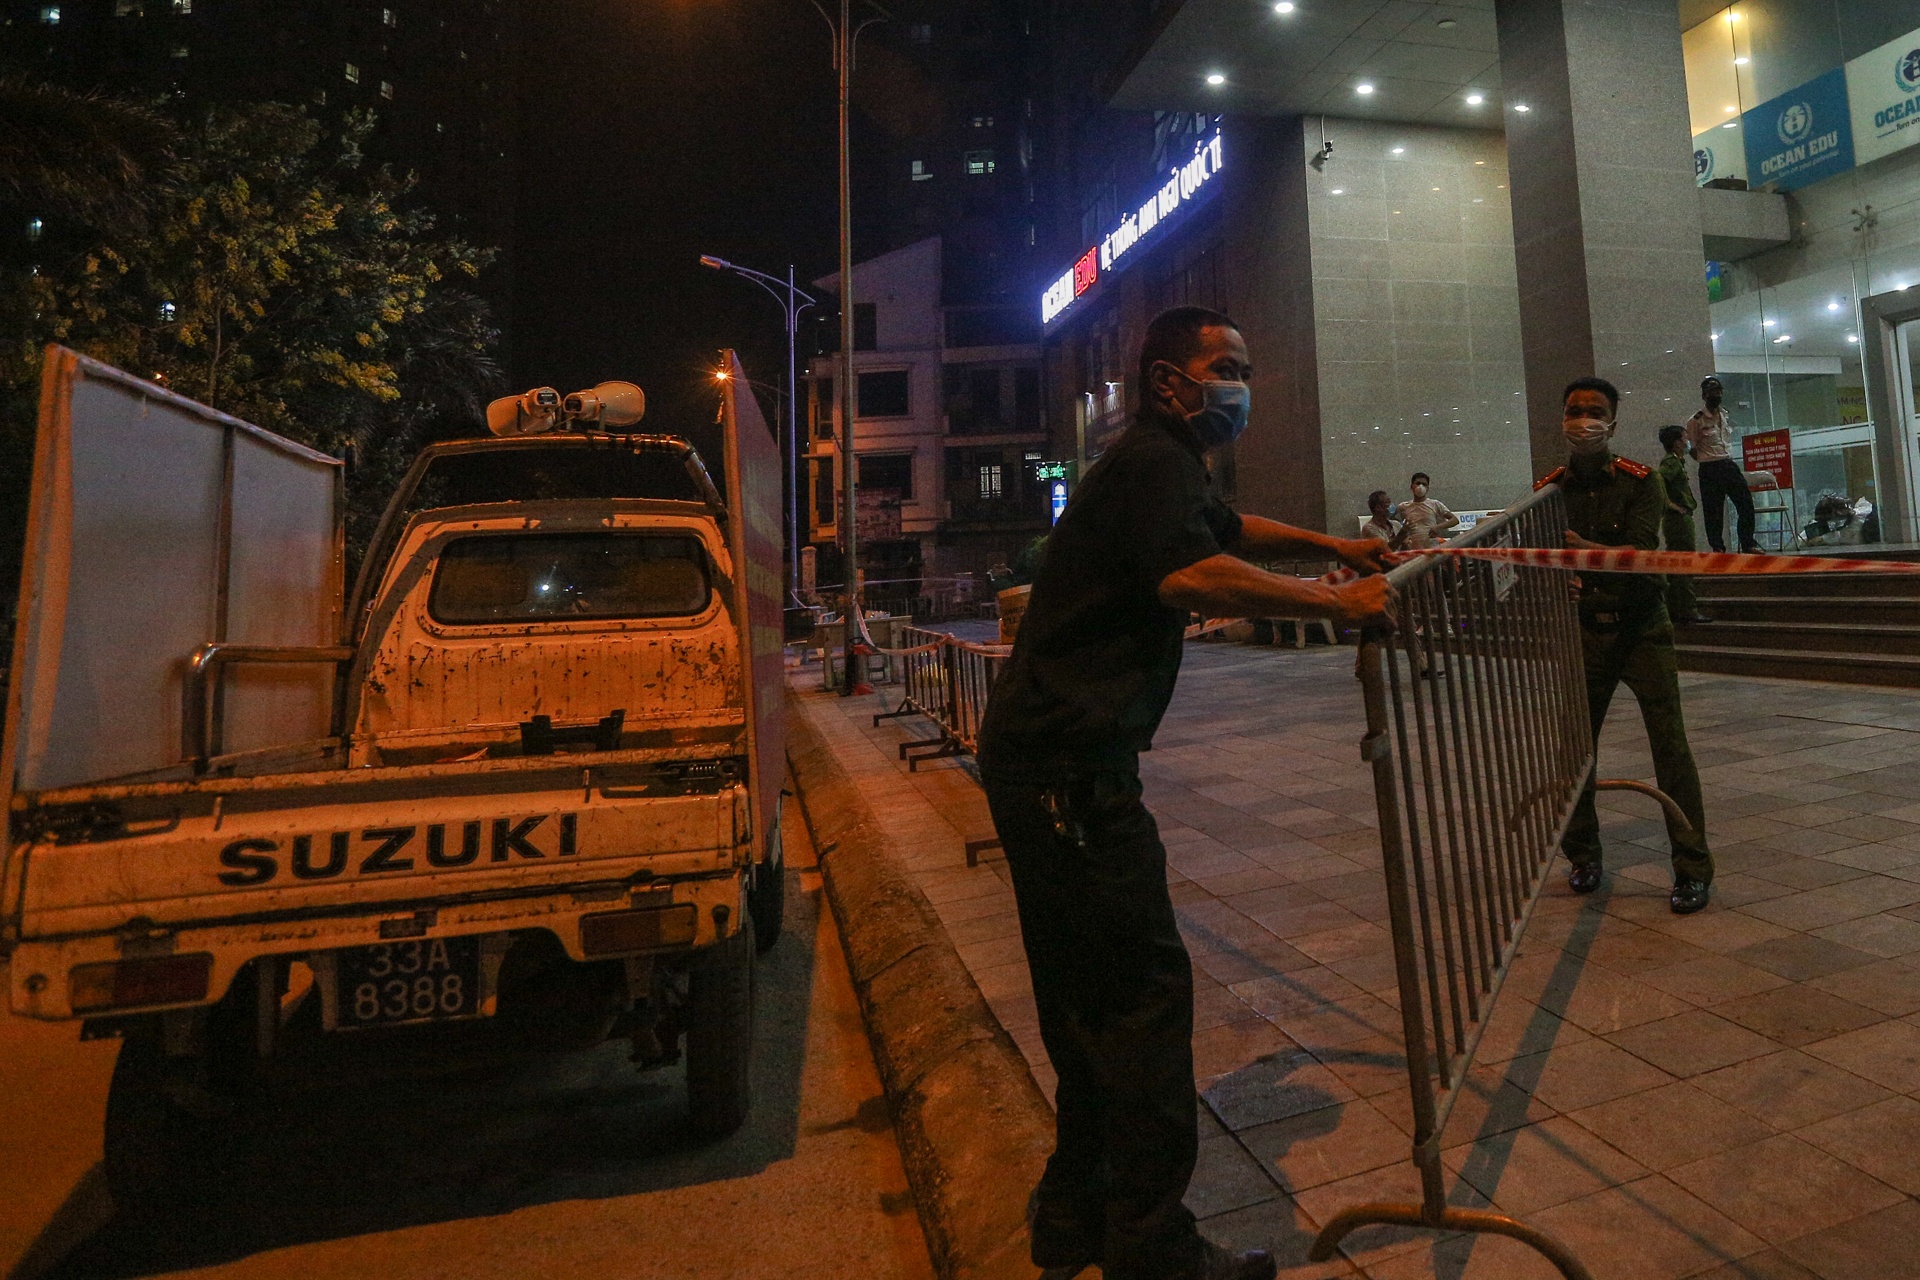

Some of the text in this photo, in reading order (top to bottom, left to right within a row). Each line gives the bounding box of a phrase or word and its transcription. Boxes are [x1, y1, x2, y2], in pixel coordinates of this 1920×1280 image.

[1761, 130, 1838, 175] OCEAN EDU
[1042, 267, 1074, 324] OCEAN
[1074, 246, 1097, 297] EDU
[1101, 233, 1112, 272] HỆ
[1110, 212, 1139, 260] THỐNG
[1138, 195, 1158, 238] ANH
[1158, 166, 1180, 220] NGỮ
[1180, 140, 1210, 200] QUỐC
[217, 813, 577, 886] SUZUKI
[368, 940, 450, 977] 33A
[355, 974, 463, 1020] 8388
